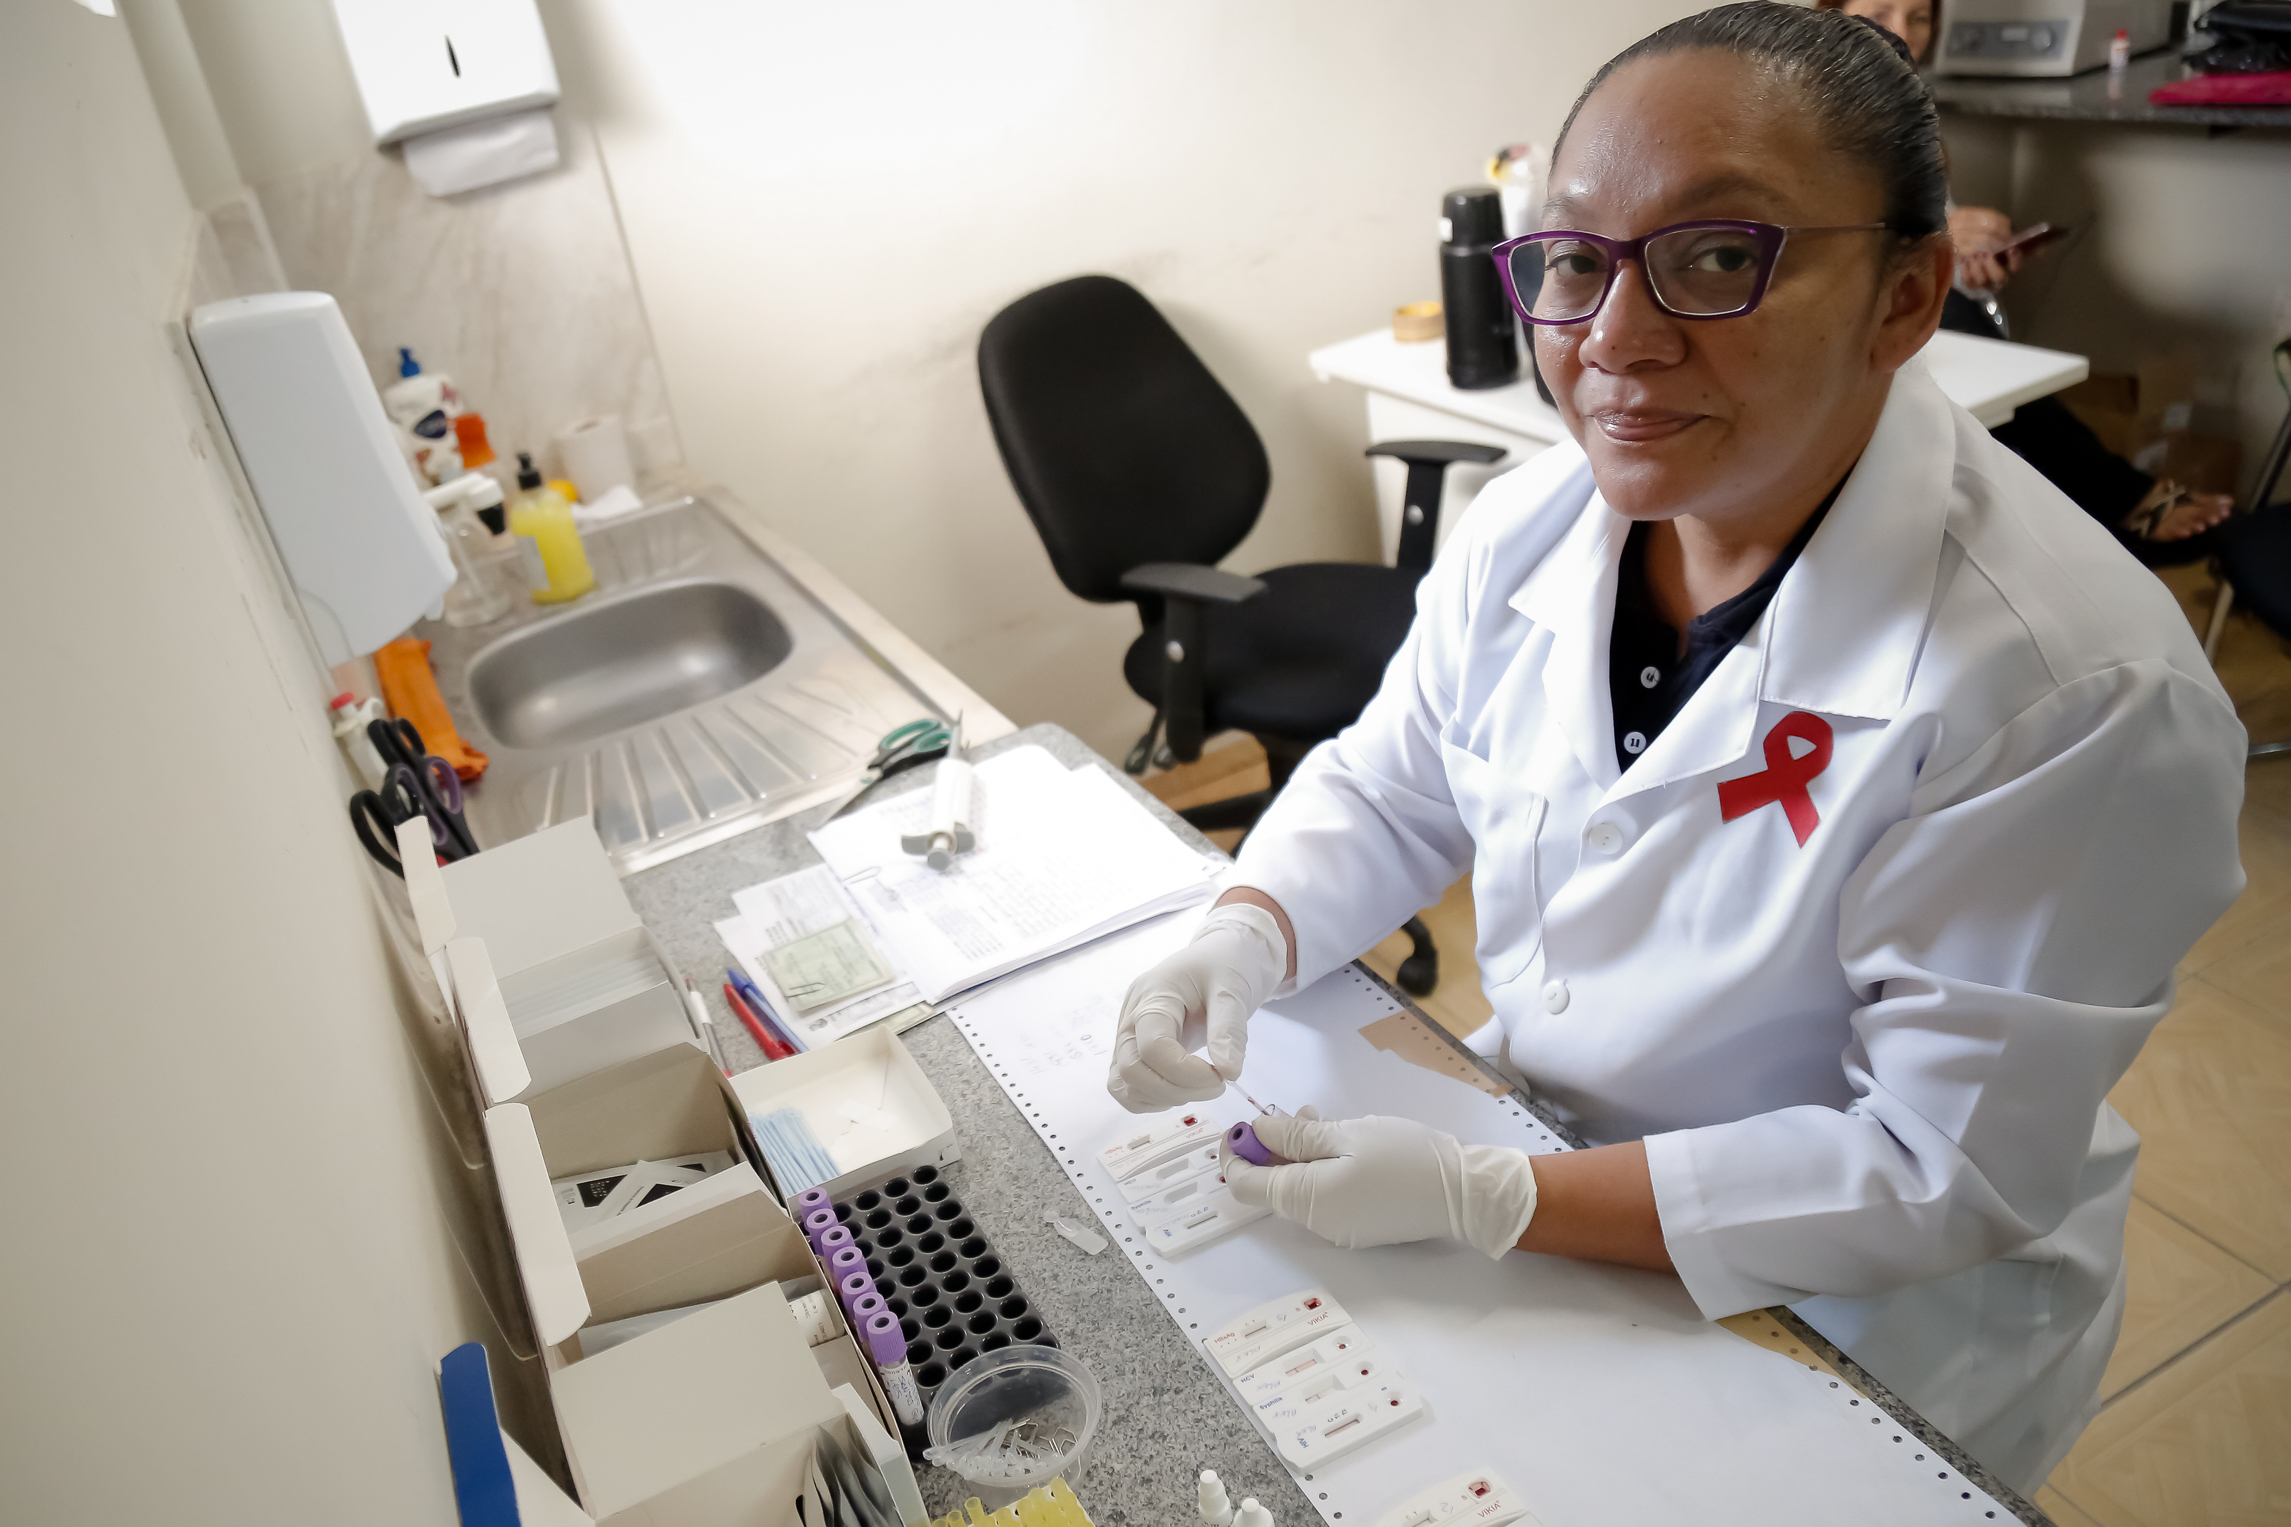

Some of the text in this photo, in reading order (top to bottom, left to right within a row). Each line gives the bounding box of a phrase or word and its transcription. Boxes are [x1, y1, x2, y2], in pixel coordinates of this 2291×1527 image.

[1240, 1373, 1255, 1383] HCV
[1259, 1396, 1283, 1410] Syphilis
[1298, 1437, 1309, 1449] HIV
[1477, 1502, 1501, 1518] VIKIA
